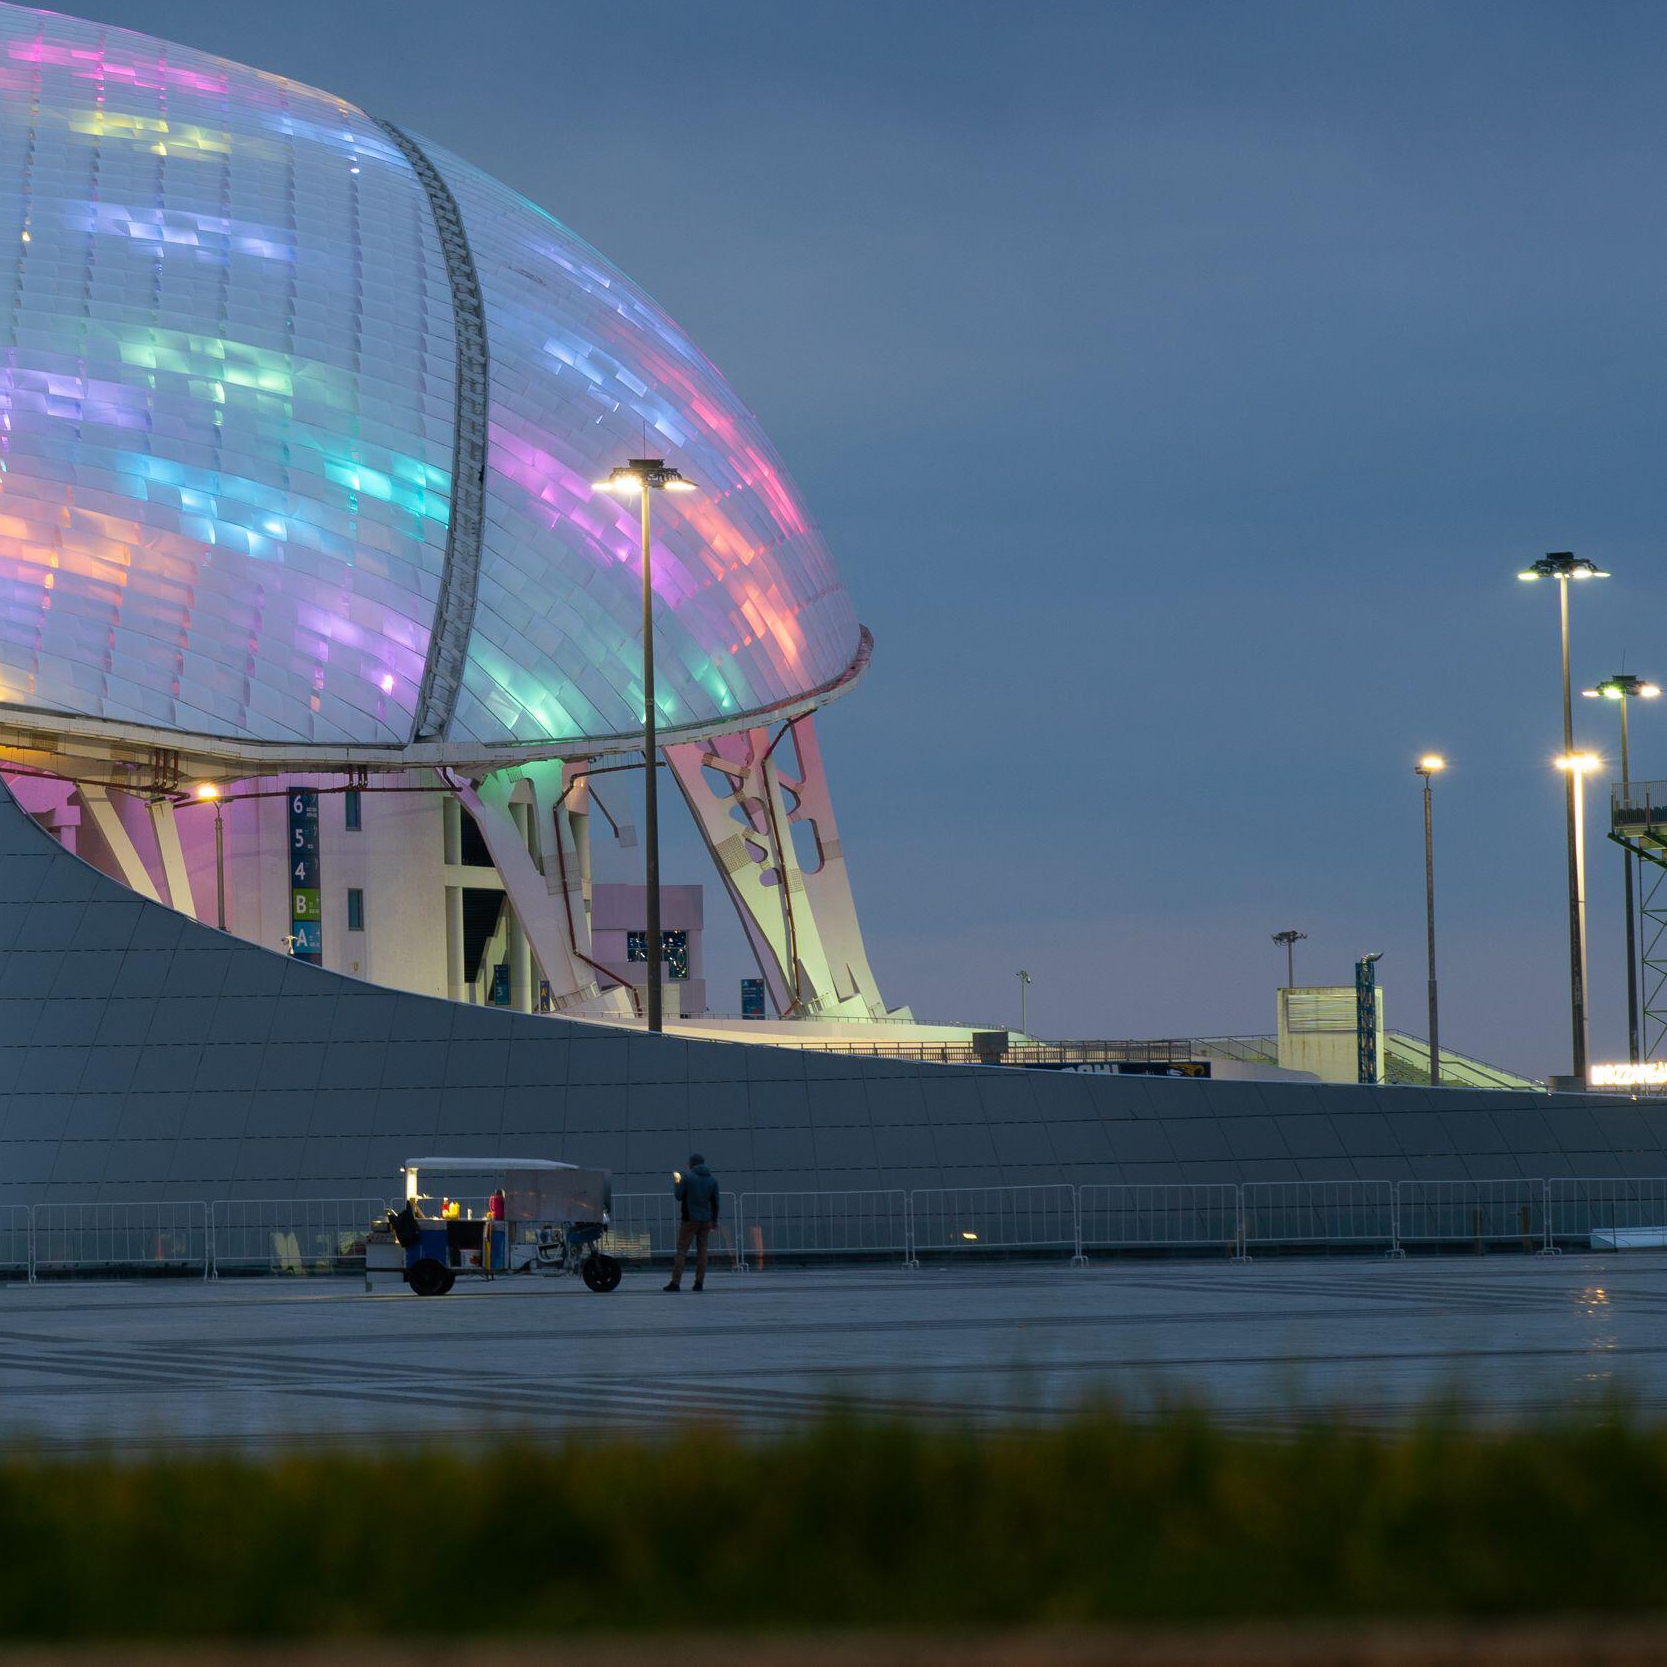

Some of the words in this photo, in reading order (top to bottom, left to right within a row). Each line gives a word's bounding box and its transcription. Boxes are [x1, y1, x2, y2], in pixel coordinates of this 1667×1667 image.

[293, 794, 303, 814] 6
[295, 828, 304, 848] 5
[294, 861, 306, 881] 4
[296, 894, 307, 914] B
[296, 928, 308, 947] A
